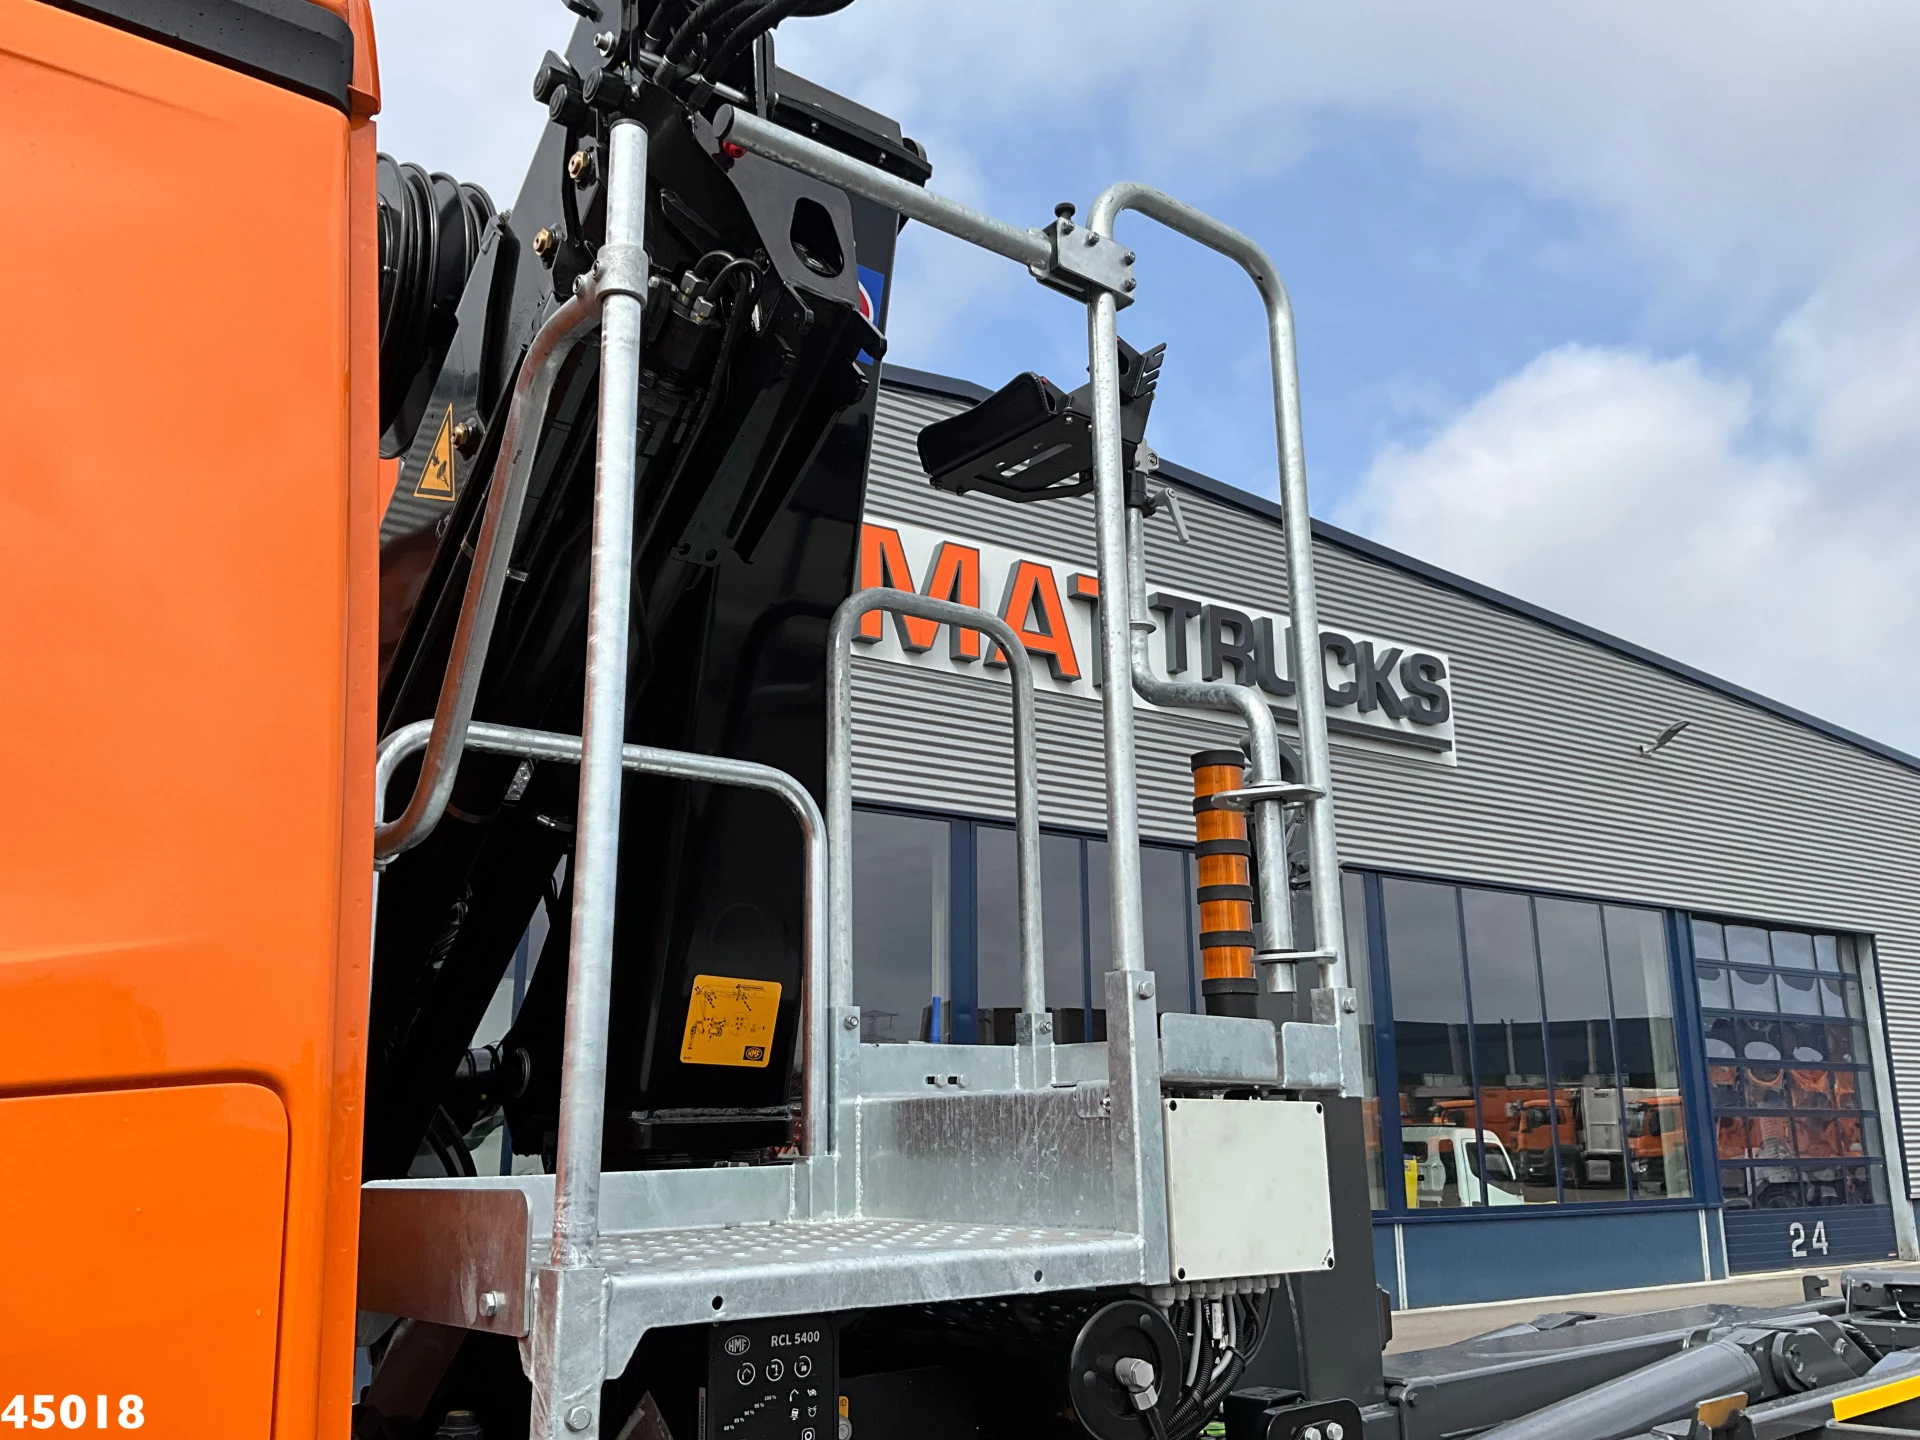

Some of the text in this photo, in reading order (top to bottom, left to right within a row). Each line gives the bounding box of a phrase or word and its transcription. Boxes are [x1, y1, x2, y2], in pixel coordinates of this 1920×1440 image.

[1148, 592, 1450, 726] TRUCKS
[1789, 1221, 1828, 1257] 24
[728, 1338, 747, 1353] HMF
[771, 1331, 820, 1347] RCL 5400
